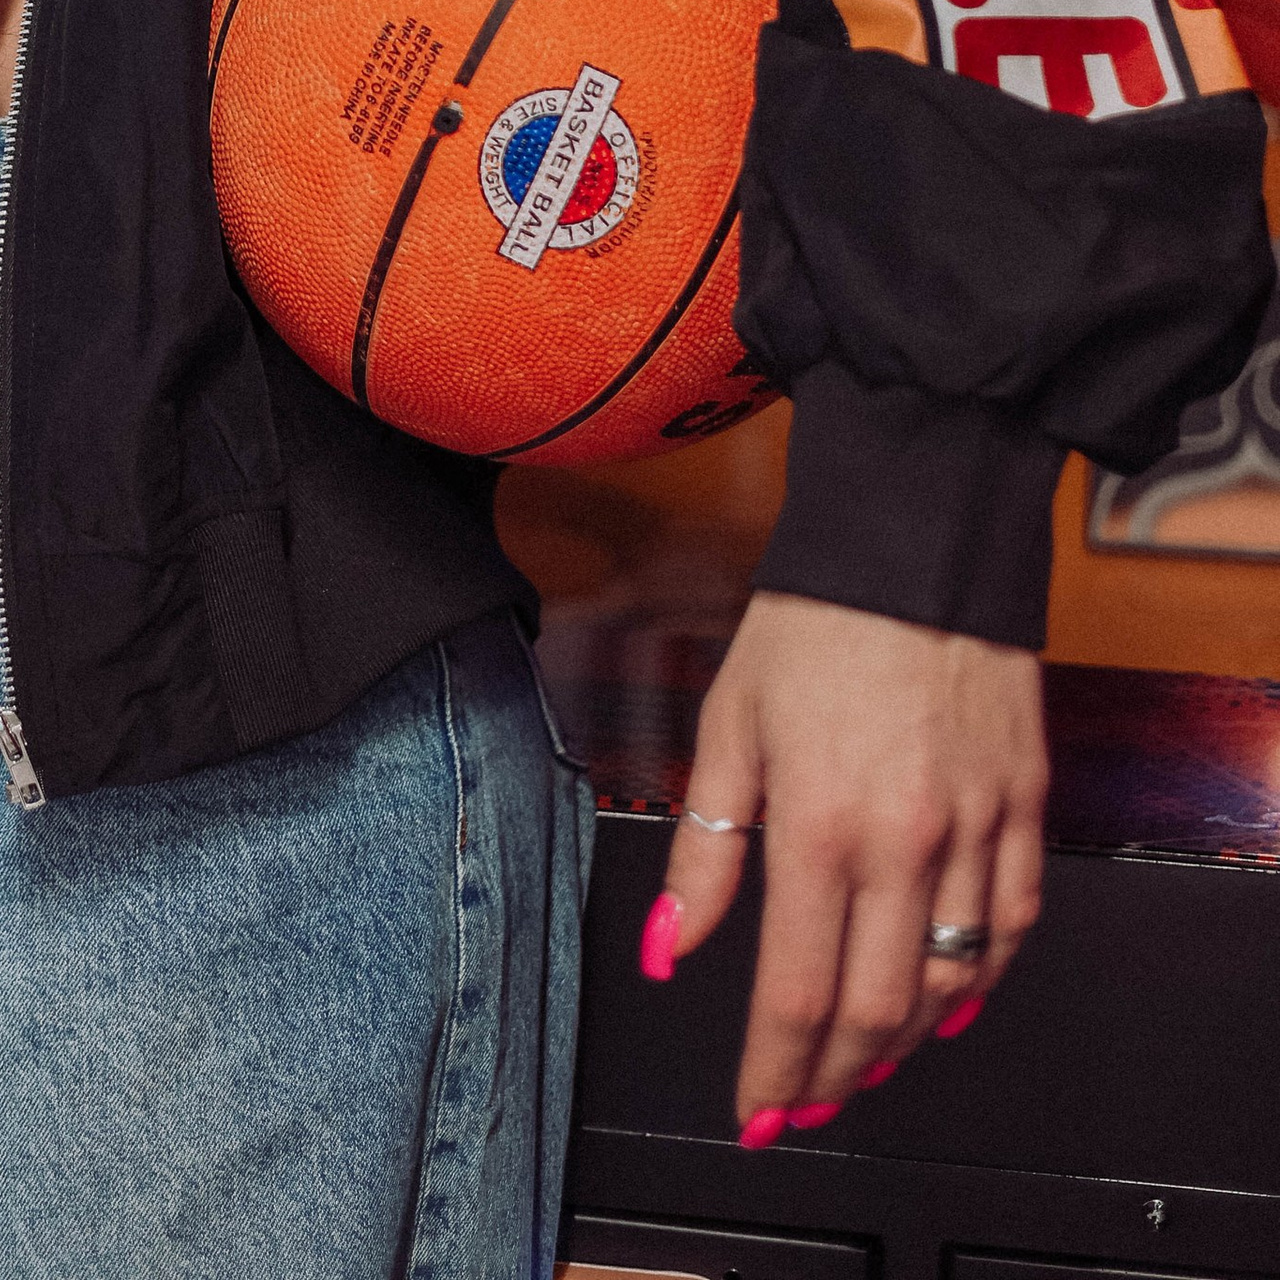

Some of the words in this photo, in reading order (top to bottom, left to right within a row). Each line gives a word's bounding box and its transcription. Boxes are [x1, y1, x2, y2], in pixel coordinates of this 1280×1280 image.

[368, 20, 397, 61] MADE
[381, 15, 418, 74] INFLATE
[395, 24, 432, 81] BEFORE
[339, 77, 367, 121] CHINA
[371, 75, 388, 95] TO
[404, 40, 444, 104] MOISTEN
[362, 80, 403, 154] INSERTING
[378, 103, 412, 158] NEEDLE
[498, 118, 515, 132] &
[513, 96, 558, 121] SIZE
[545, 77, 605, 190] BASKET
[484, 135, 513, 209] WEIGHT
[560, 131, 635, 242] OFFICIAL
[509, 192, 554, 256] BALL
